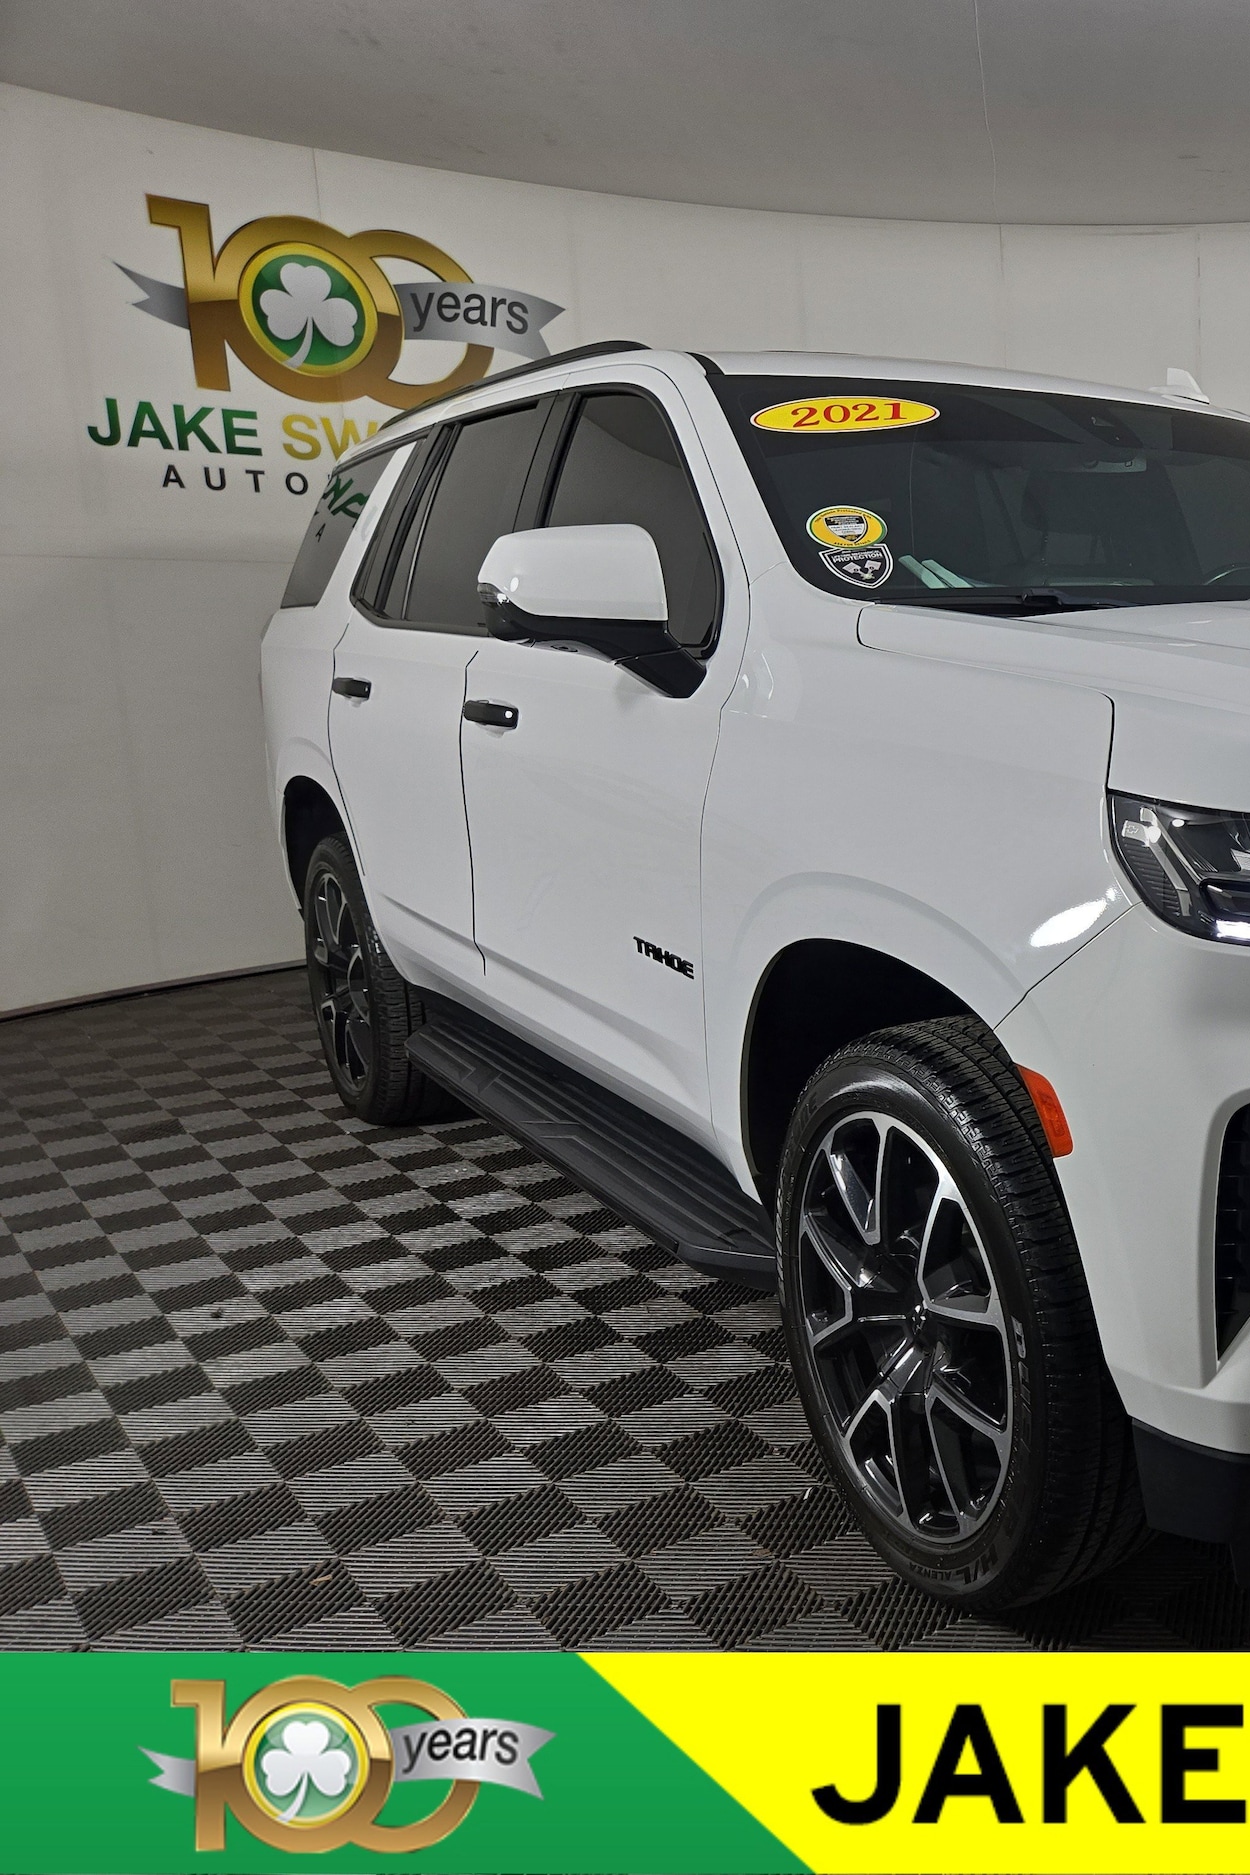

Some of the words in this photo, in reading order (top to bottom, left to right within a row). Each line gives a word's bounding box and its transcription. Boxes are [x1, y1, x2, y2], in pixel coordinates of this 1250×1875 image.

[410, 291, 529, 335] years
[87, 397, 263, 456] JAKE
[790, 402, 908, 428] 2021
[633, 936, 694, 980] TAHOE
[909, 1561, 953, 1582] ALENZA
